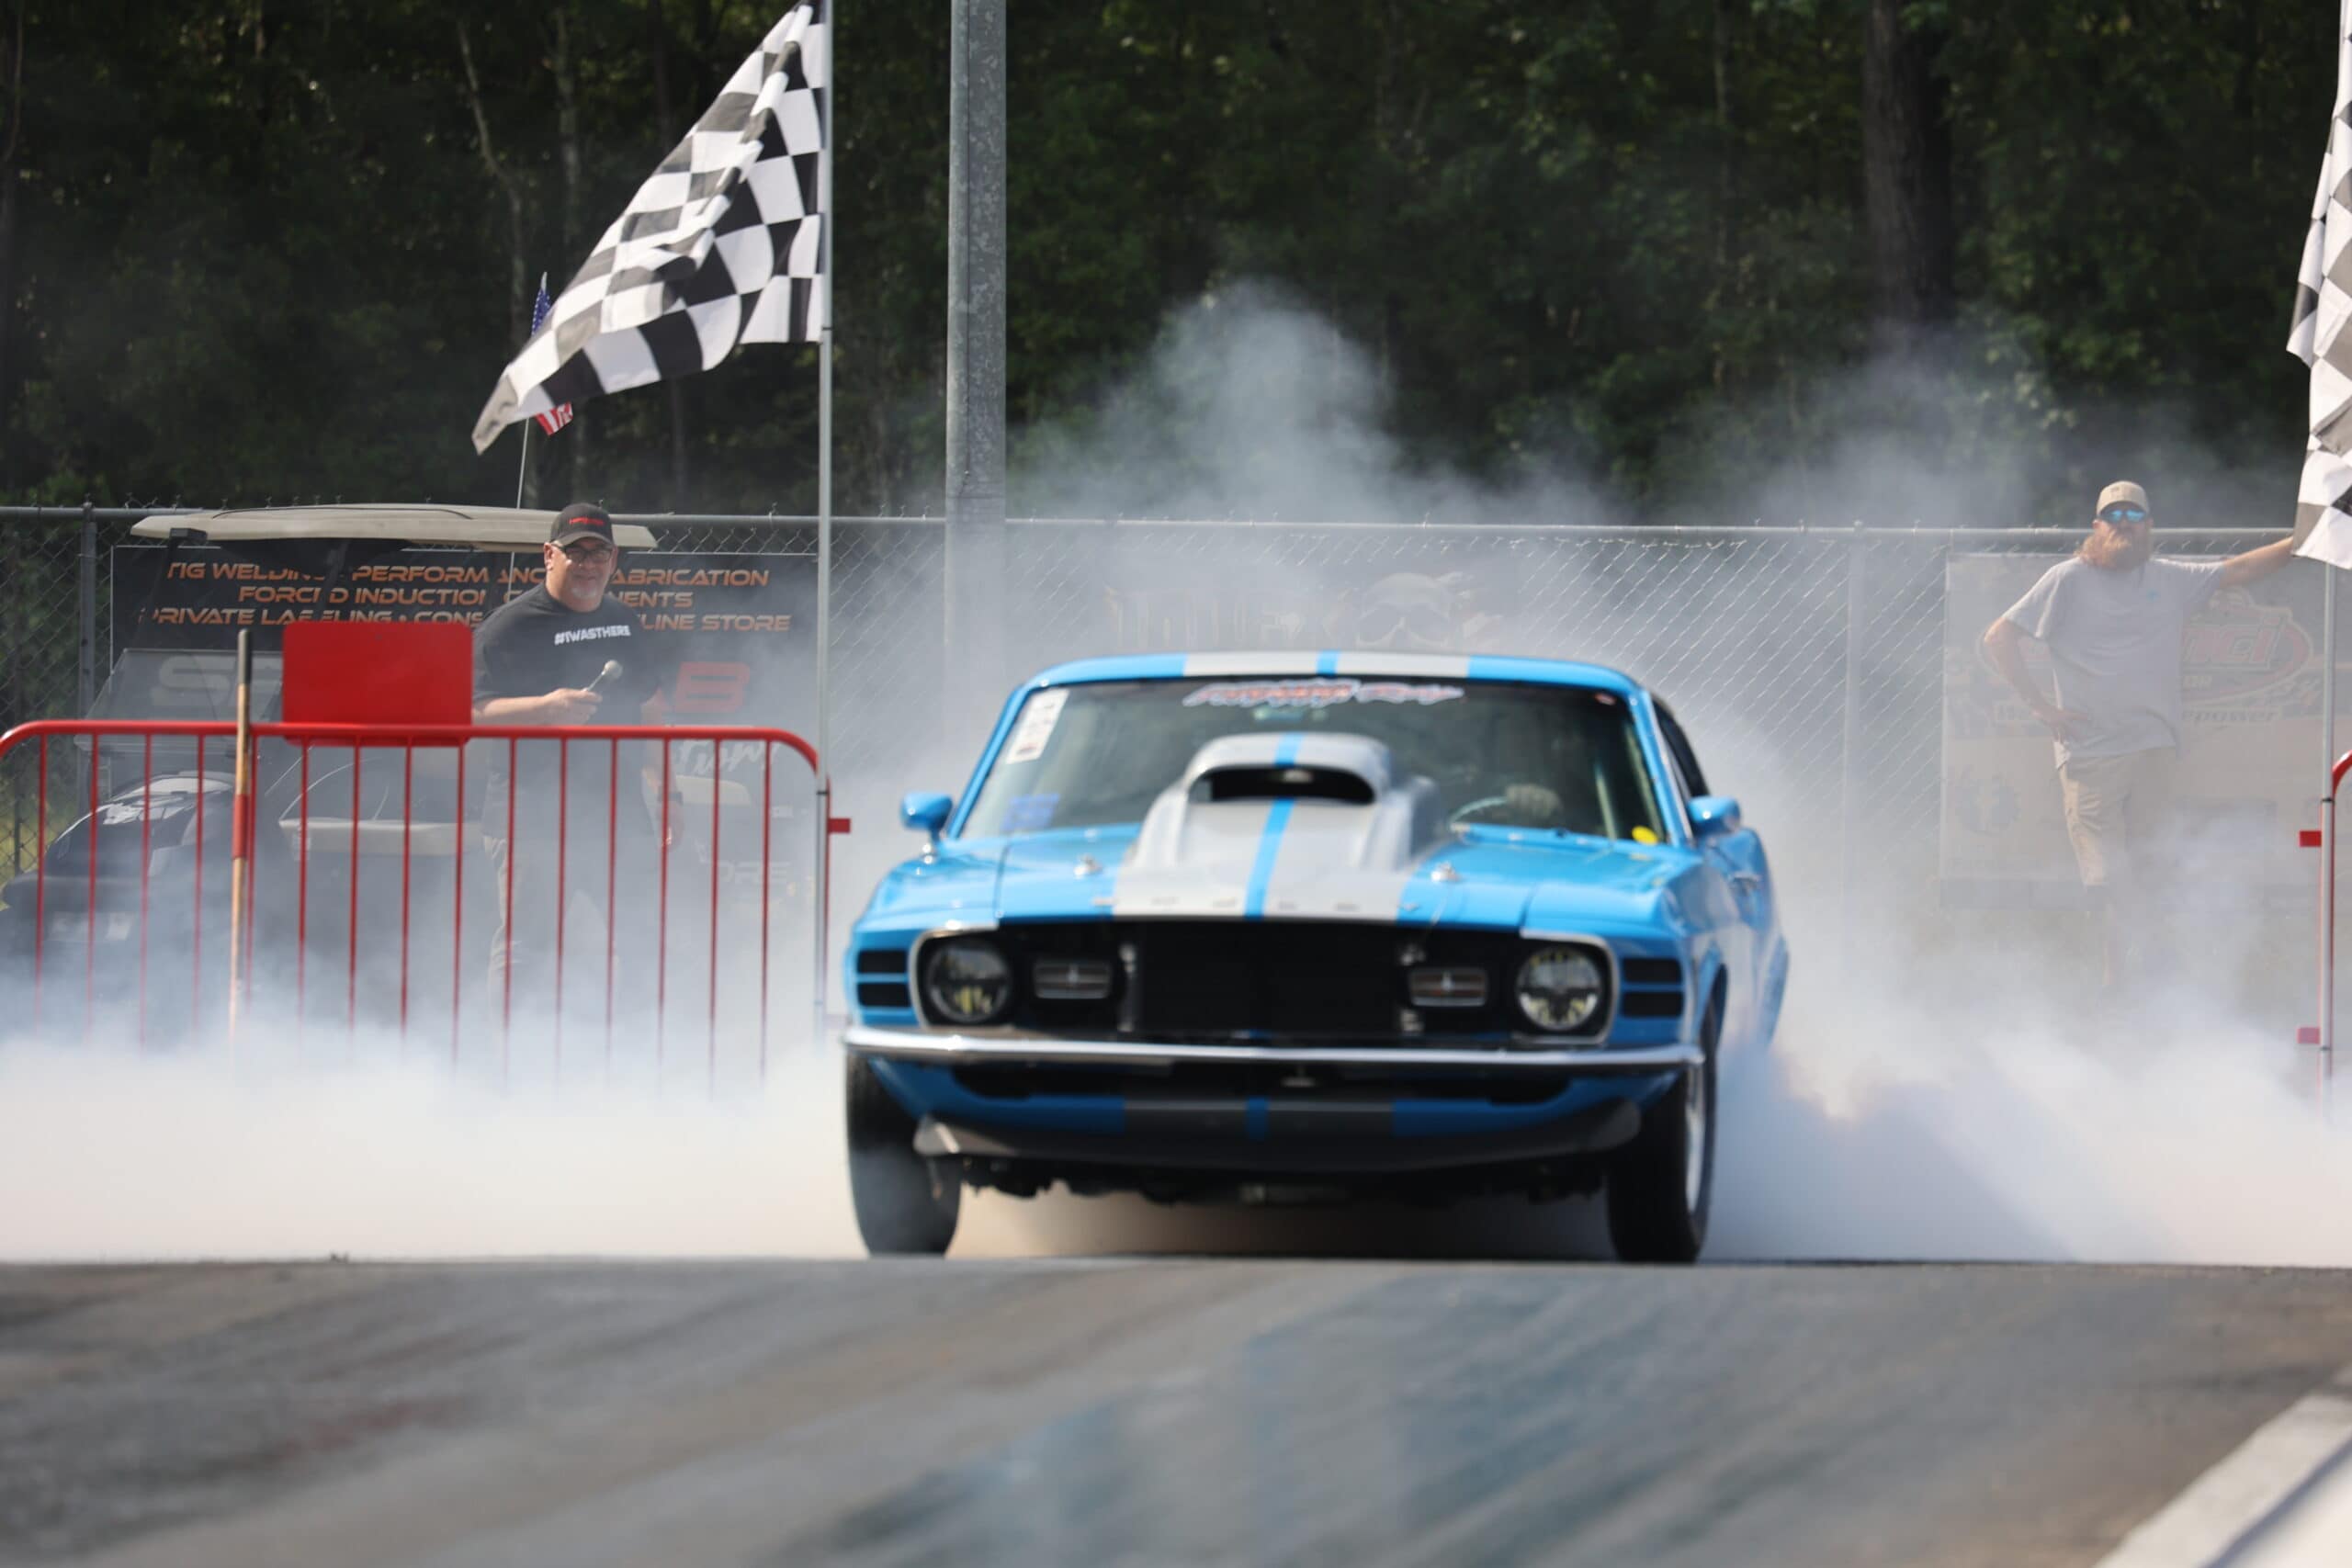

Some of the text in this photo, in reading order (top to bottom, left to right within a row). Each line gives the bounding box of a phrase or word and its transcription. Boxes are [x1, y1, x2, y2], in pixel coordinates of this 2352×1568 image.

[167, 562, 207, 580] TIG
[352, 565, 547, 583] PERFORMANC
[611, 569, 770, 586] ABRICATION
[139, 607, 255, 625] RIVATE
[701, 614, 793, 632] STORE
